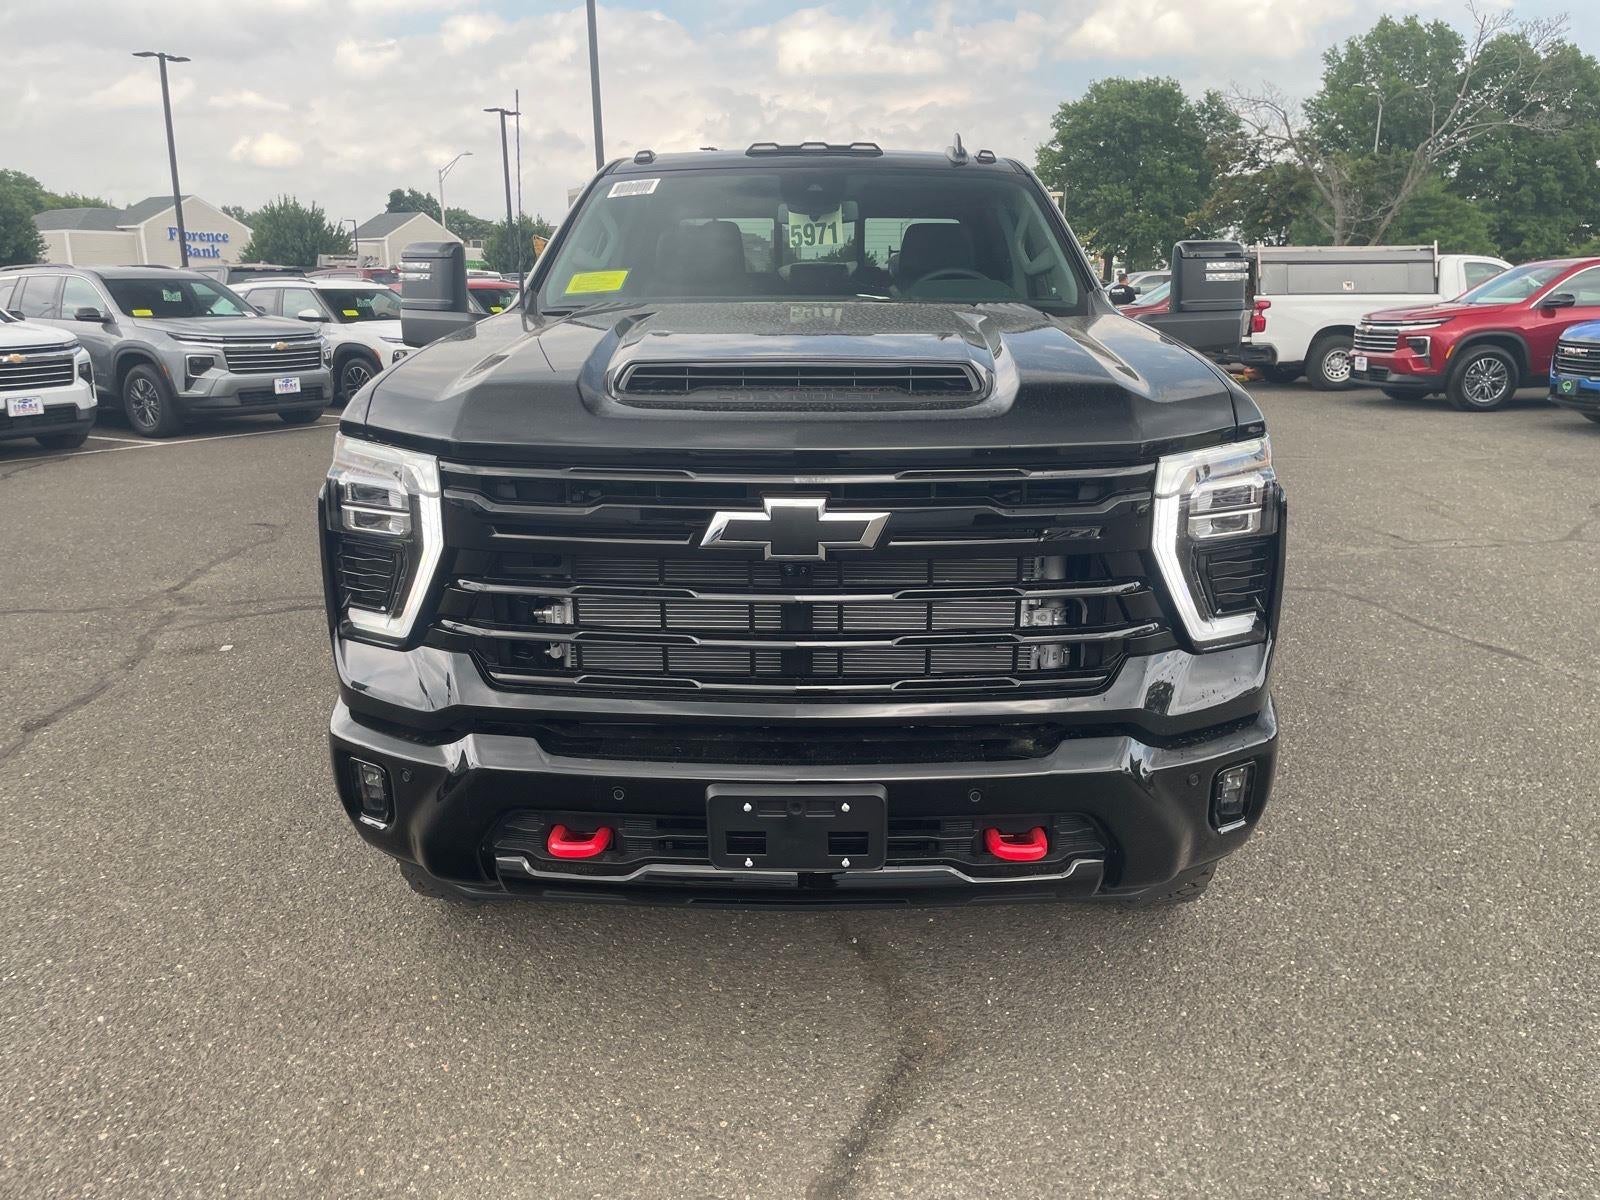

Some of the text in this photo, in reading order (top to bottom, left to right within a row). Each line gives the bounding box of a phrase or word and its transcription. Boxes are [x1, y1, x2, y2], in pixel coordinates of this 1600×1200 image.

[168, 226, 229, 242] Forence
[791, 222, 838, 247] 5971
[183, 243, 220, 258] Bank
